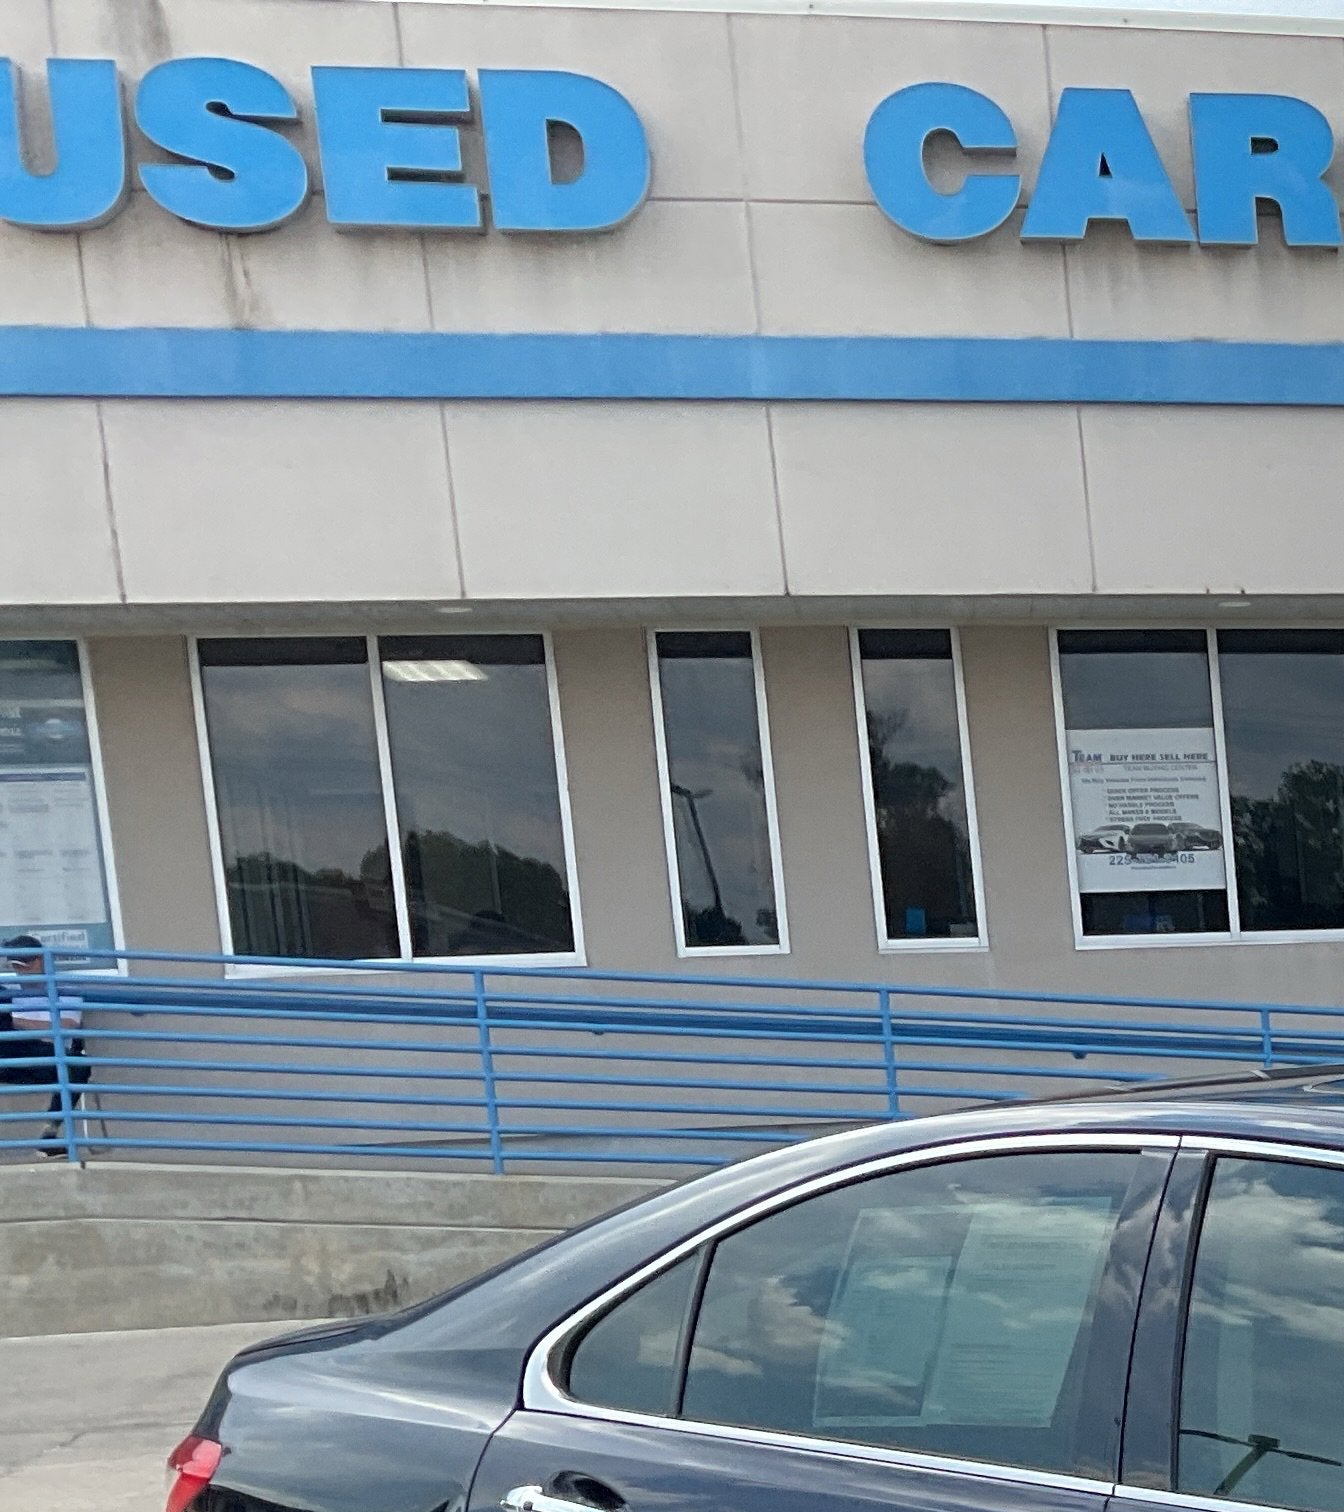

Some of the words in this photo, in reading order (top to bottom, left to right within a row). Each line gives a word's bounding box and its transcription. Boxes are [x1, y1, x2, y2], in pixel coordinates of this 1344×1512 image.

[0, 56, 652, 234] USED
[1072, 750, 1102, 762] TEAM
[1110, 753, 1128, 761] BUY
[1160, 753, 1180, 761] SELL
